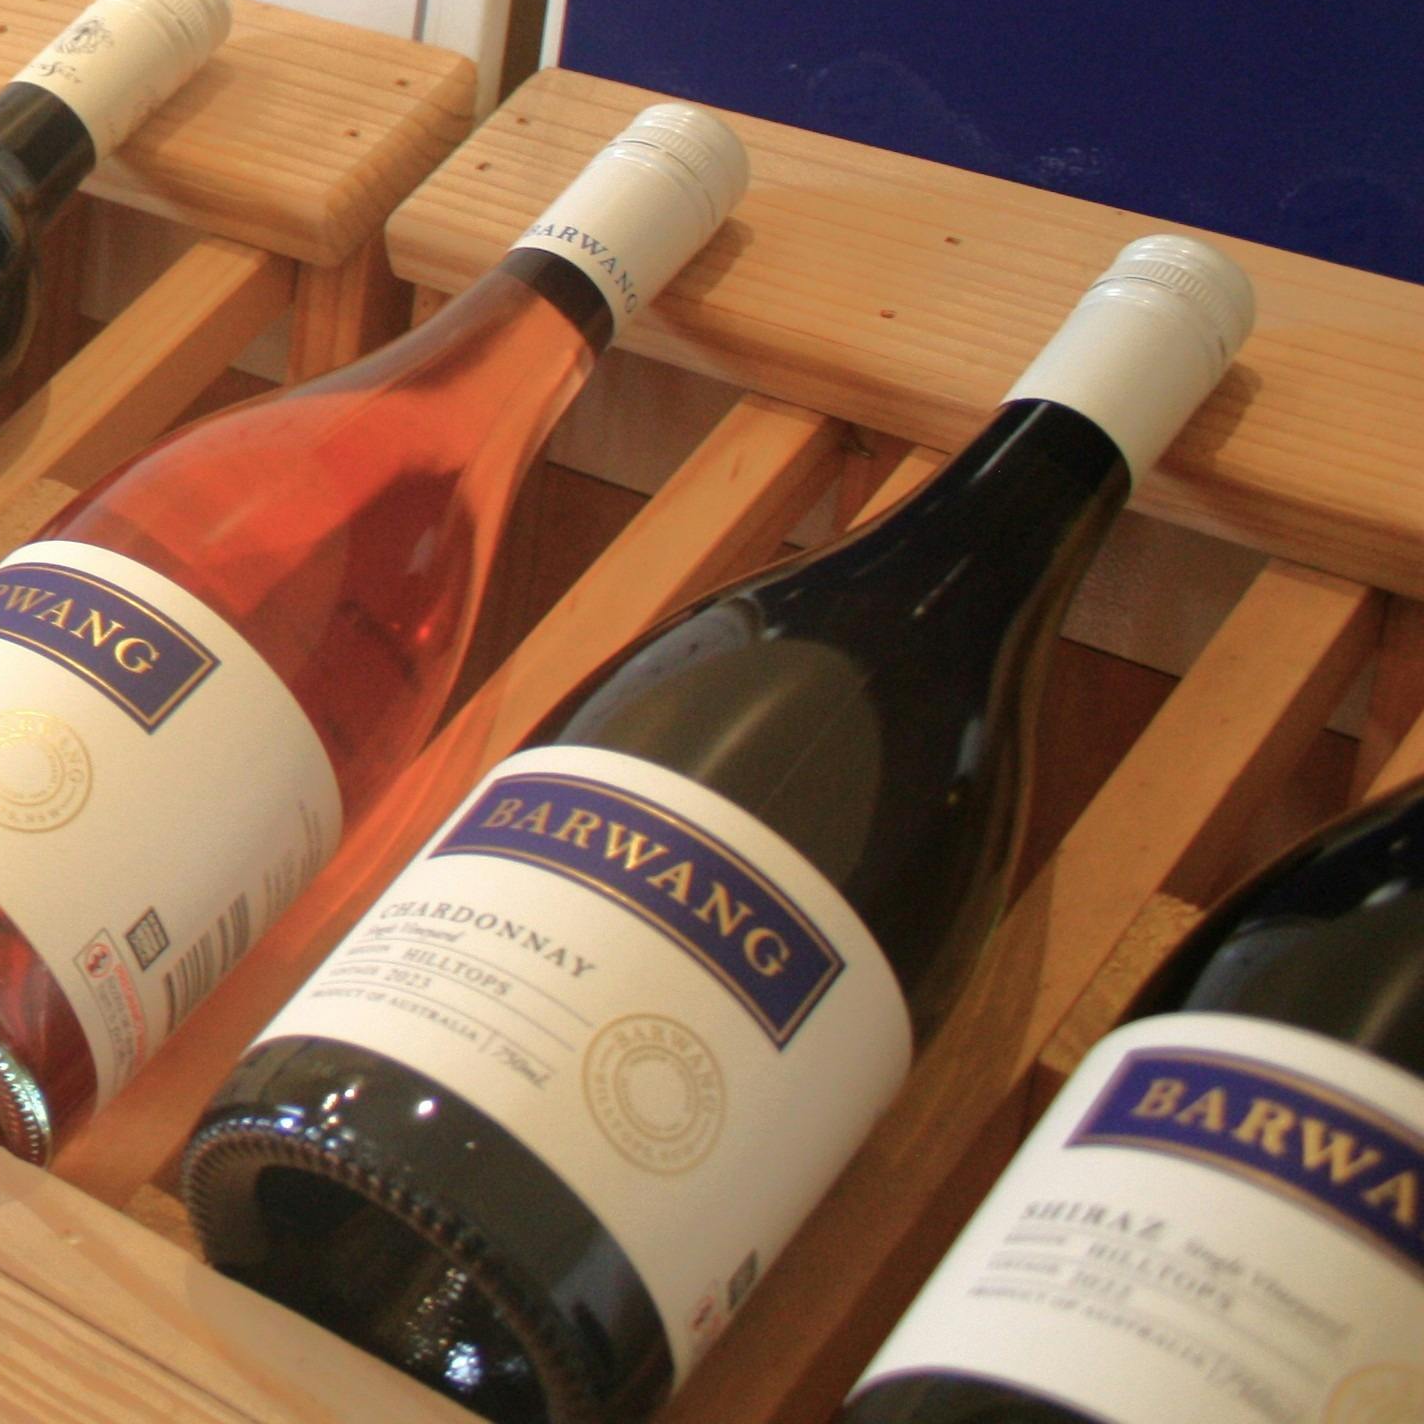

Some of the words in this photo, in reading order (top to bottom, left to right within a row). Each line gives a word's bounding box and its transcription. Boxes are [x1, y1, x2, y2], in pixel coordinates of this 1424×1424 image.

[479, 798, 792, 978] BARWANG
[380, 901, 596, 979] CHARDONNAY
[402, 947, 513, 997] HILLTOPS
